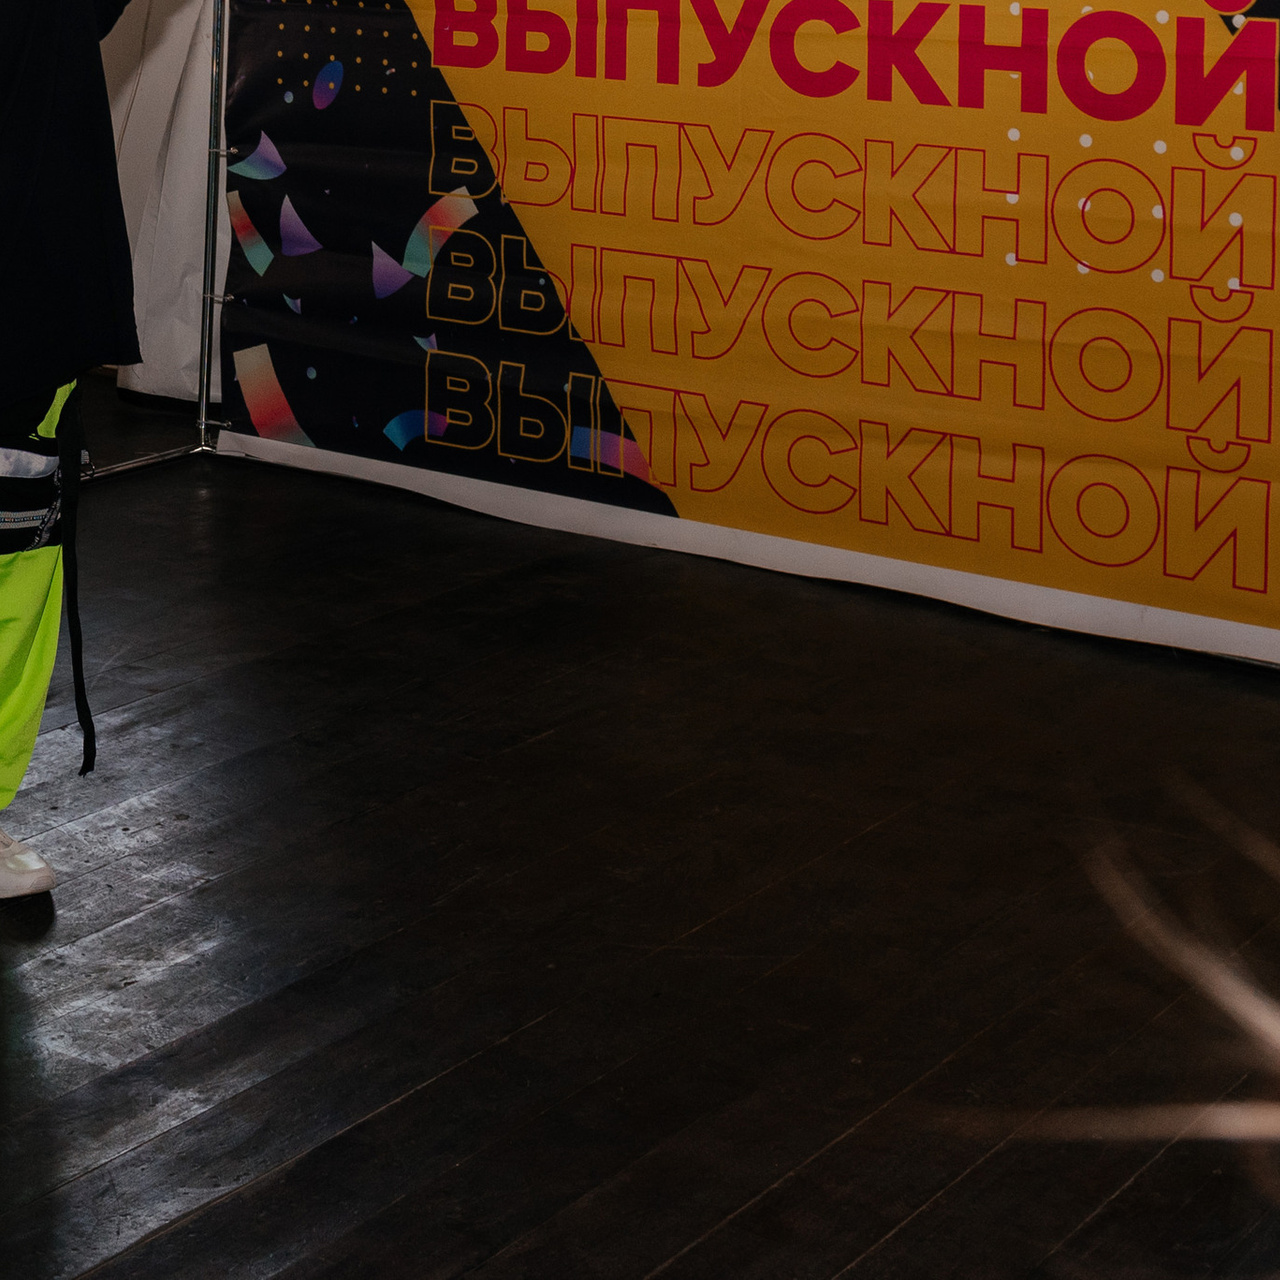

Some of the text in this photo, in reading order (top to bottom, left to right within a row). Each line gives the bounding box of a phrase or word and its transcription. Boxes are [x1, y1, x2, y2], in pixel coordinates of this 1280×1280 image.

[428, 99, 1277, 291] ВЫПУСКНОЙ
[425, 225, 1274, 444] ВЫПУСКНОЙ
[423, 348, 1272, 595] ВЫПУСКНОЙ
